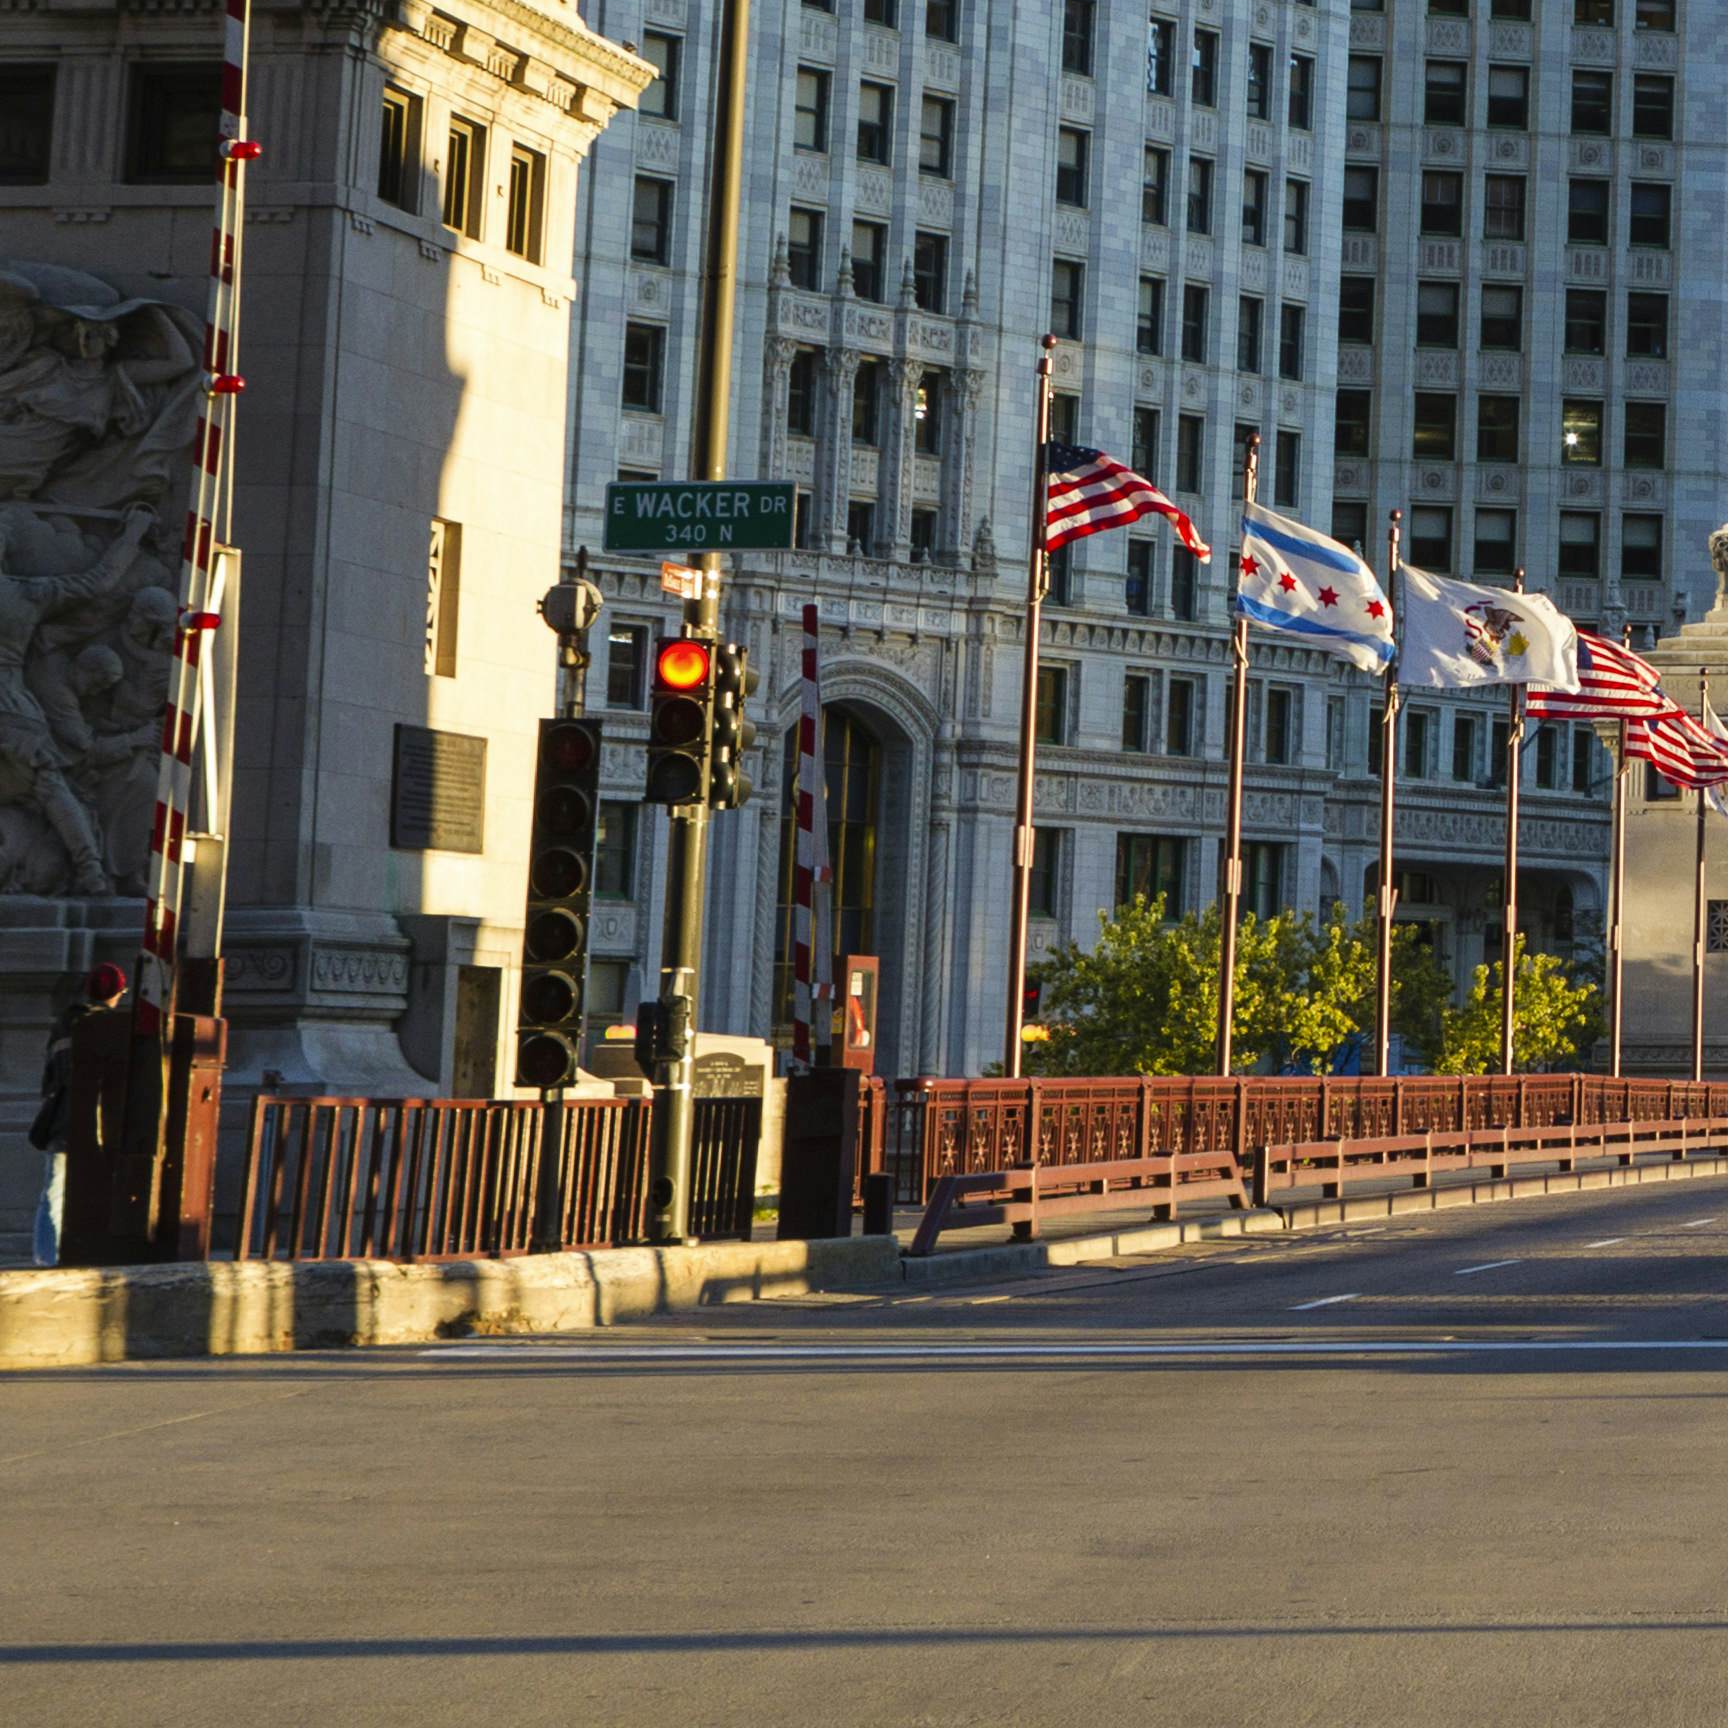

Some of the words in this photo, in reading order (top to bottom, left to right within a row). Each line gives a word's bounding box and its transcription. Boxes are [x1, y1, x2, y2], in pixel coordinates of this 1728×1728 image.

[613, 497, 625, 514] E
[636, 492, 750, 518] WACKER
[760, 496, 786, 513] DR
[665, 524, 706, 542] 340
[719, 524, 732, 542] N
